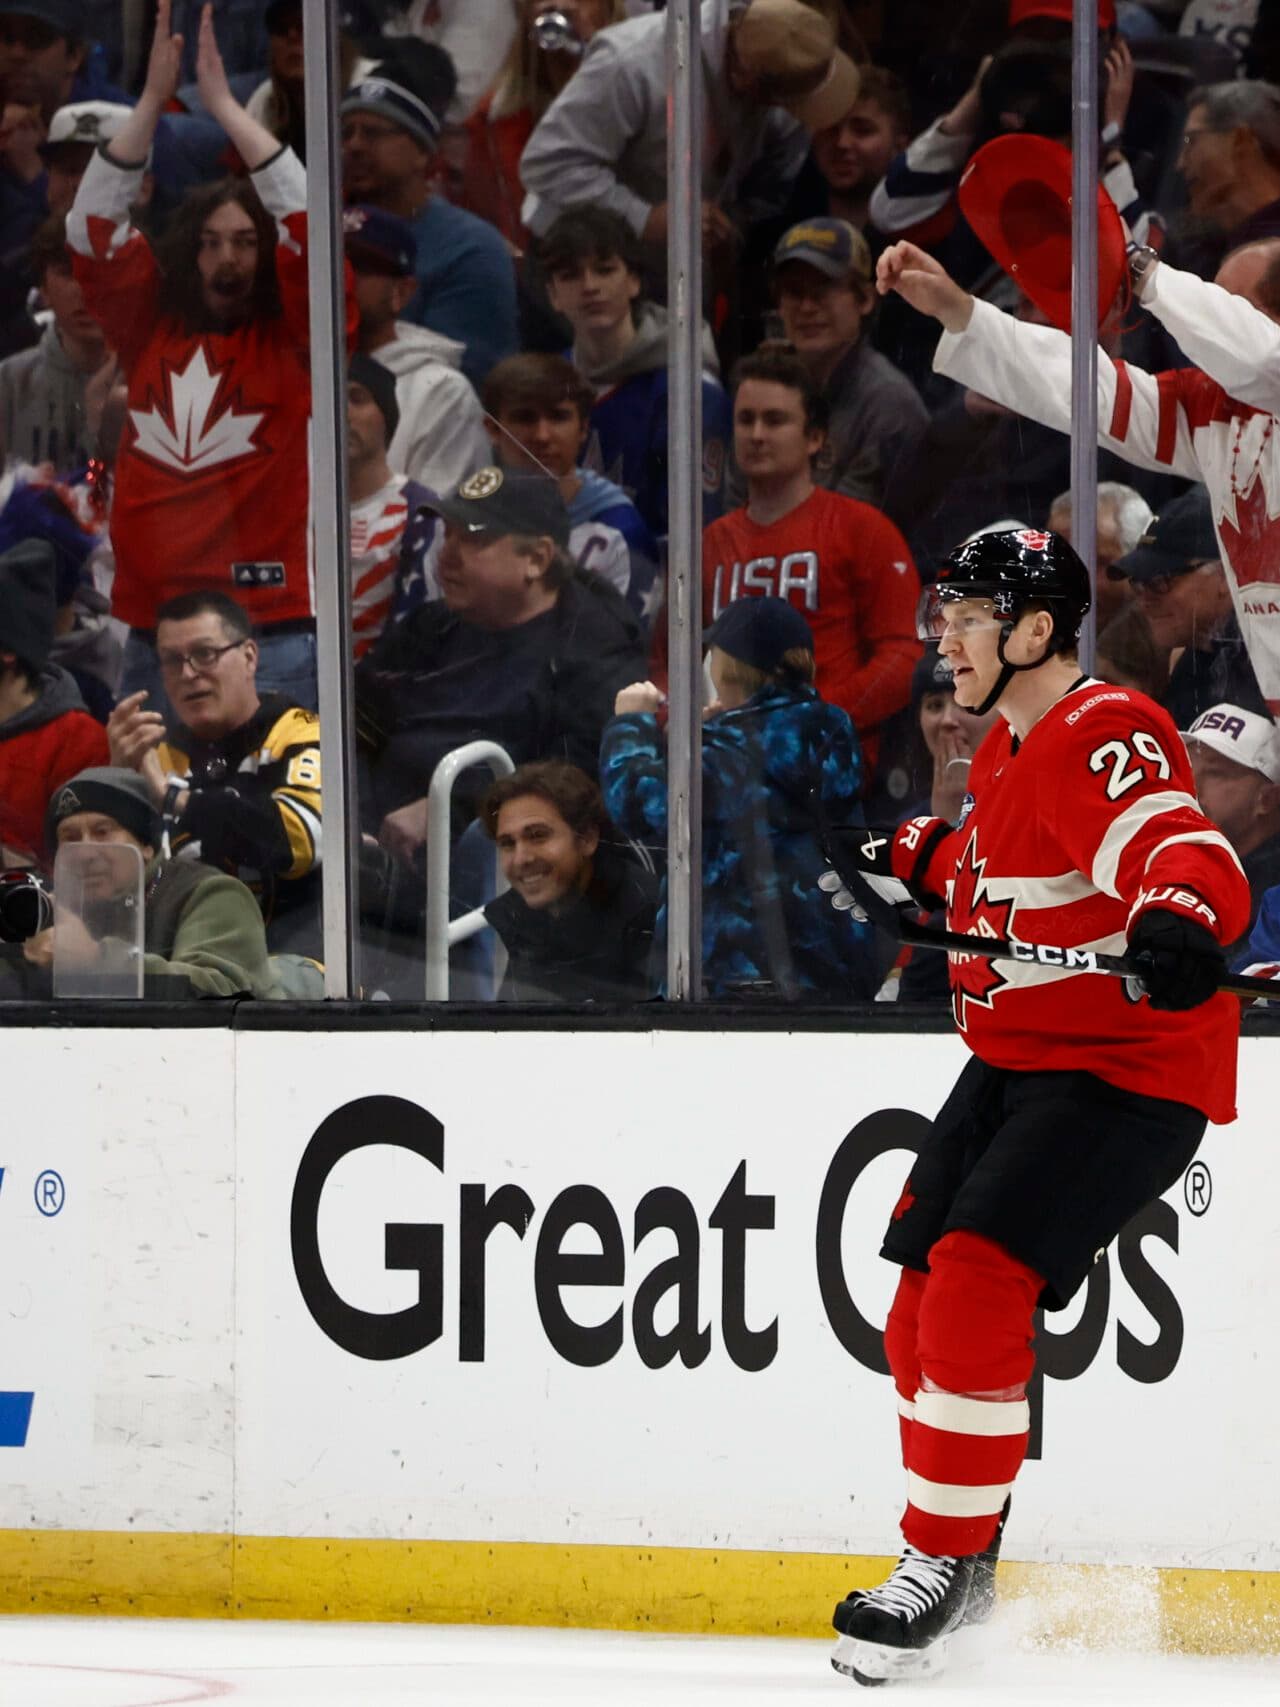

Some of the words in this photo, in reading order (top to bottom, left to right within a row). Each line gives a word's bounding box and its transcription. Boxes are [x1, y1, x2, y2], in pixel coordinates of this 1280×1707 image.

[713, 550, 819, 622] USA
[1190, 712, 1246, 742] USA
[1088, 730, 1171, 802] 29
[1009, 940, 1110, 974] CCM
[290, 1094, 779, 1373] Great
[815, 1107, 1184, 1460] Cps
